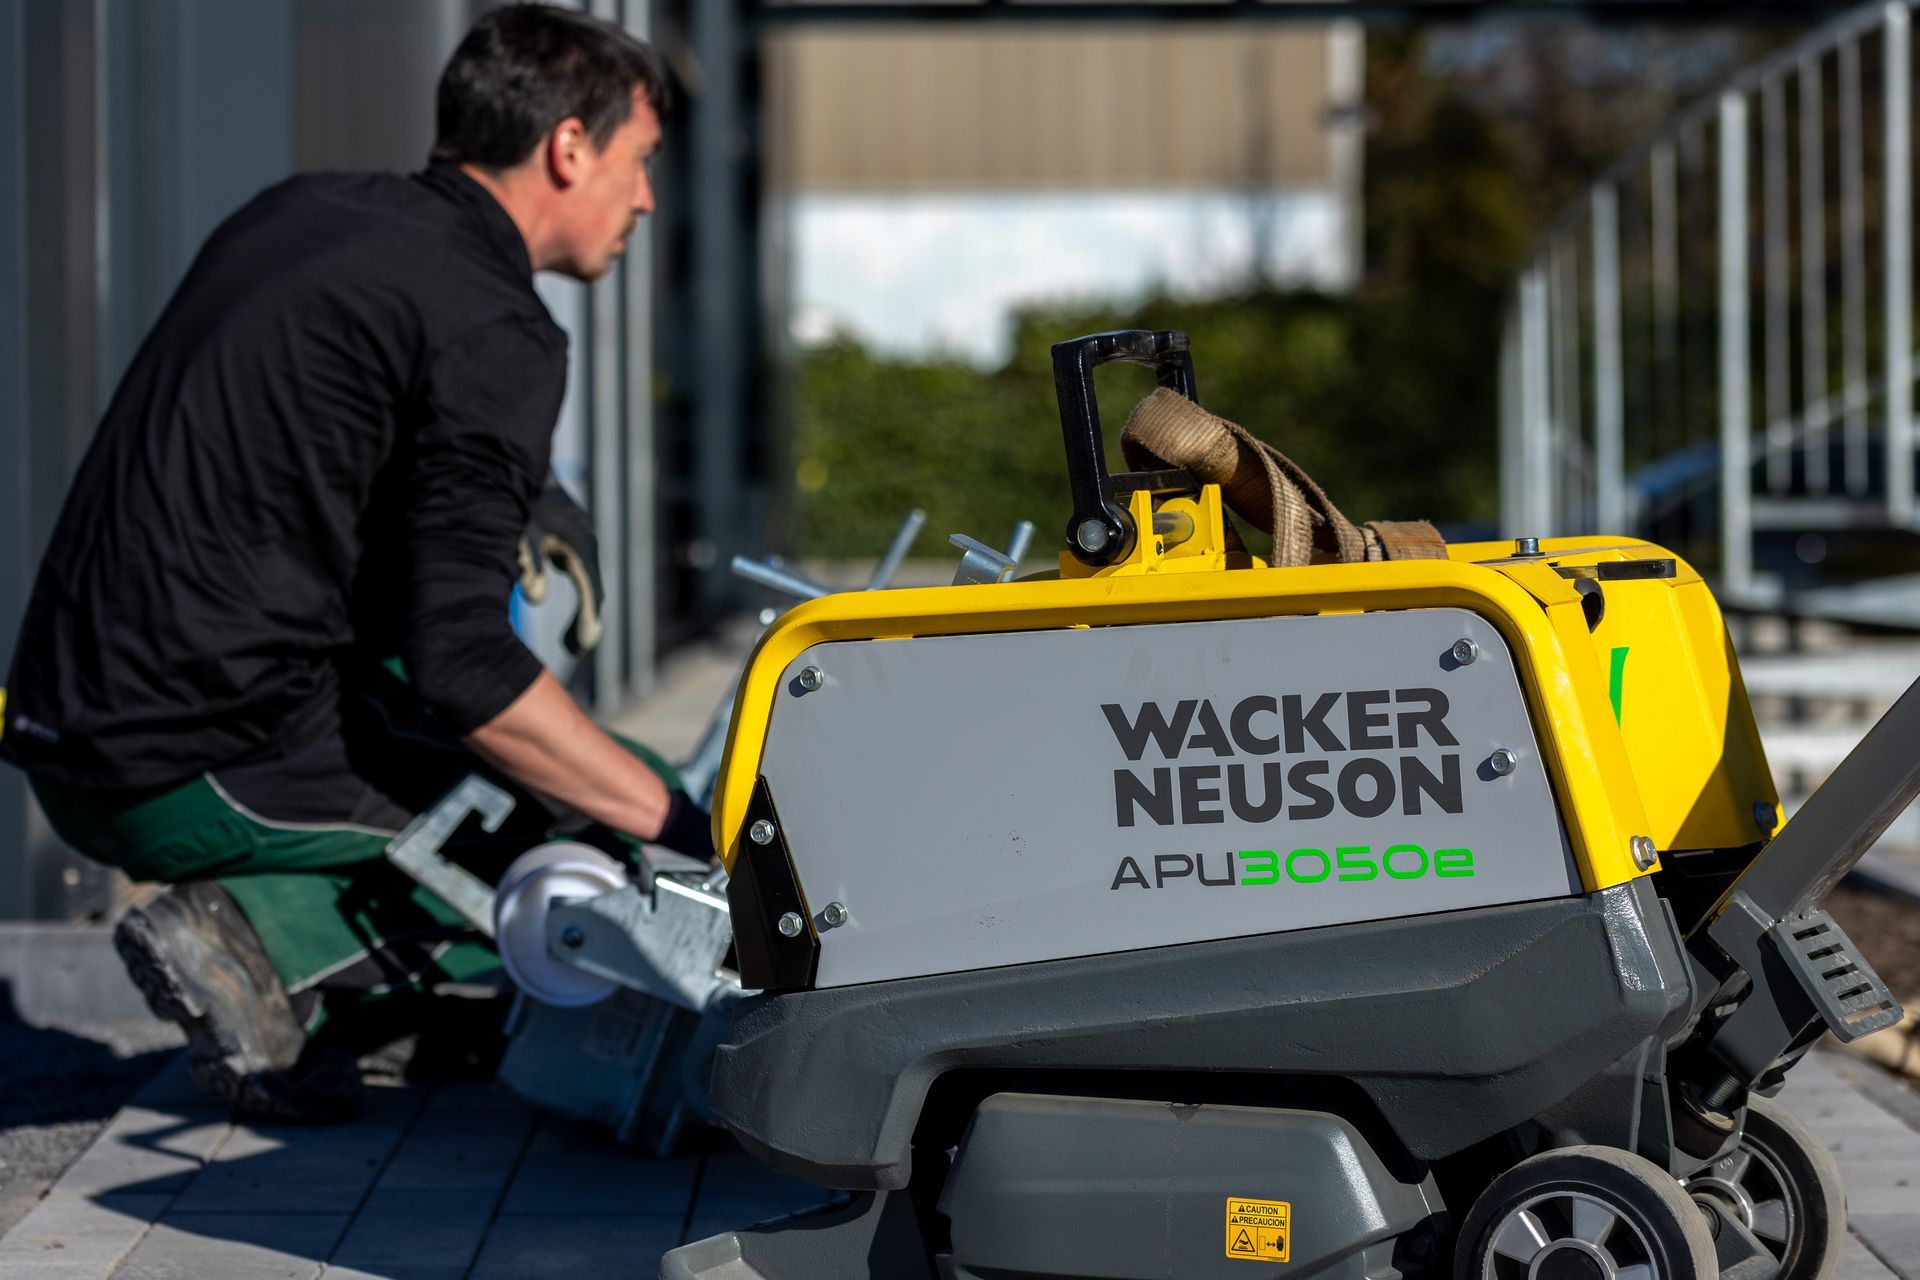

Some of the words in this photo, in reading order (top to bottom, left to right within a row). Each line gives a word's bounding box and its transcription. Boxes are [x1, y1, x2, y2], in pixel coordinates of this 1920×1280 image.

[1100, 687, 1460, 761] WACKER
[1113, 754, 1464, 827] NEUSON
[1110, 844, 1474, 890] APU3050e
[1239, 1216, 1285, 1226] PRECAUCION
[1246, 1205, 1278, 1214] CAUTION
